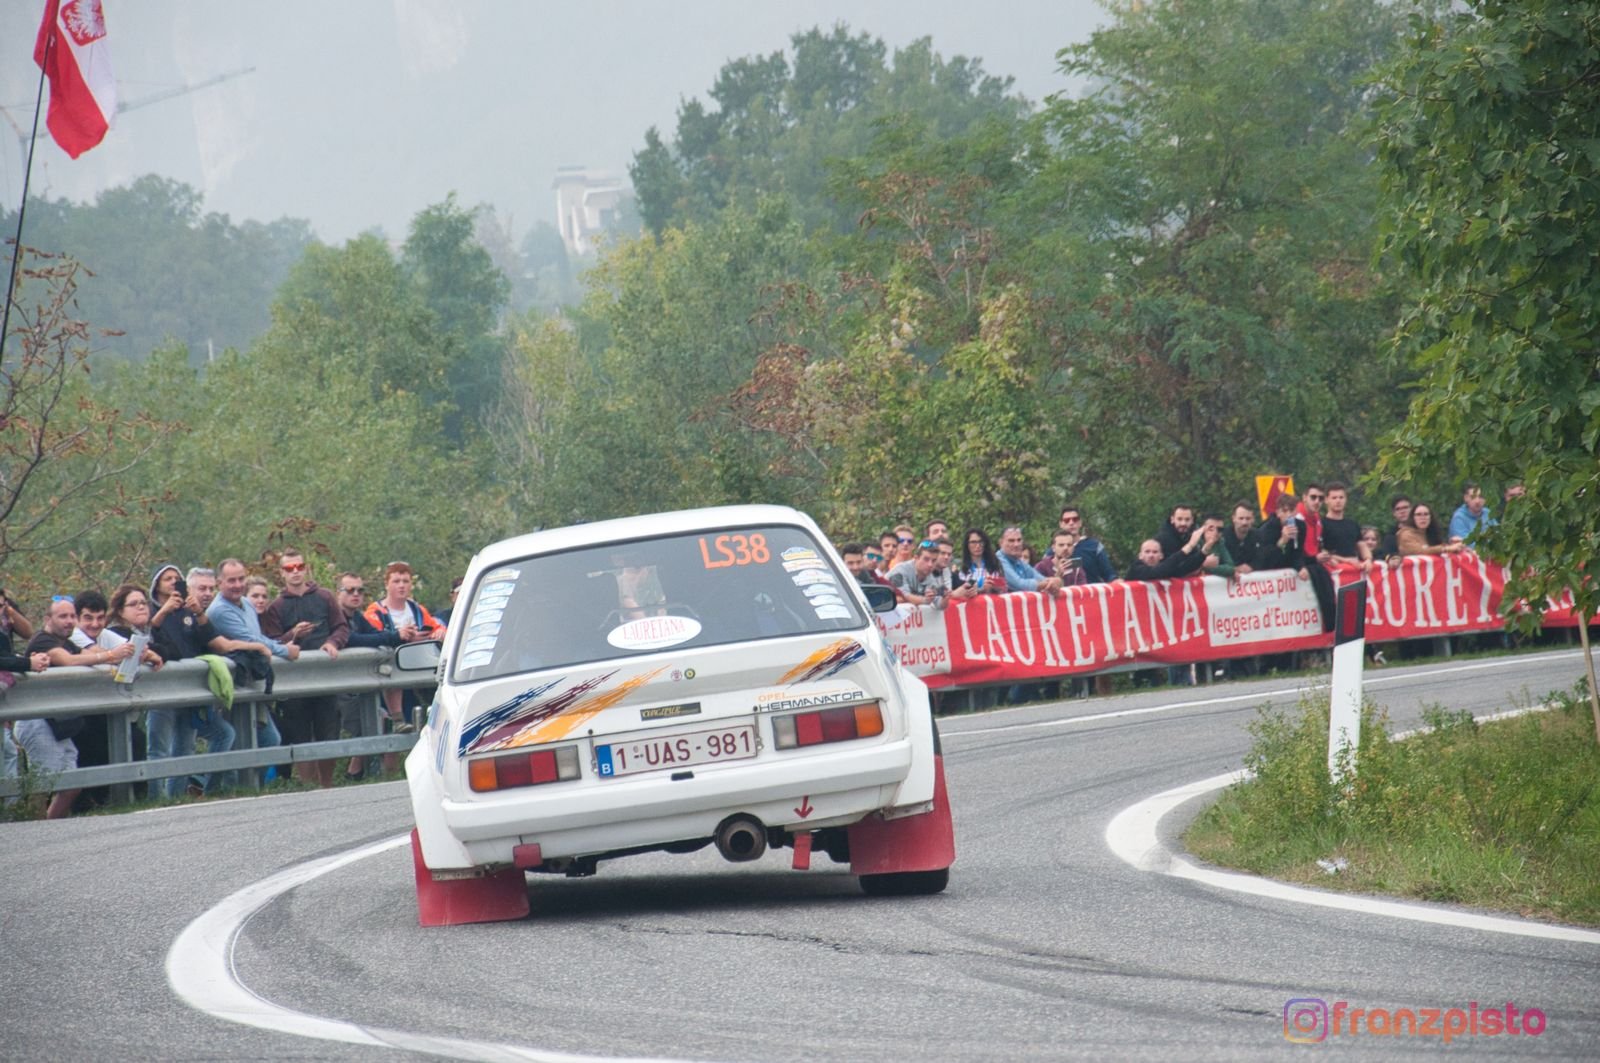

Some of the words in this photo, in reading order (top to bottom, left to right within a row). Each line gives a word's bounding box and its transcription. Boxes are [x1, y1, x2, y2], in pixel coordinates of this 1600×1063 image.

[699, 533, 770, 569] LS38
[623, 619, 687, 641] LAURETANA
[957, 580, 1205, 668] LAURETANA
[1212, 613, 1261, 638] leggera
[1263, 607, 1319, 630] d'Europa
[758, 691, 786, 702] OPEL
[759, 690, 864, 712] HERMANATOR
[601, 763, 612, 775] B
